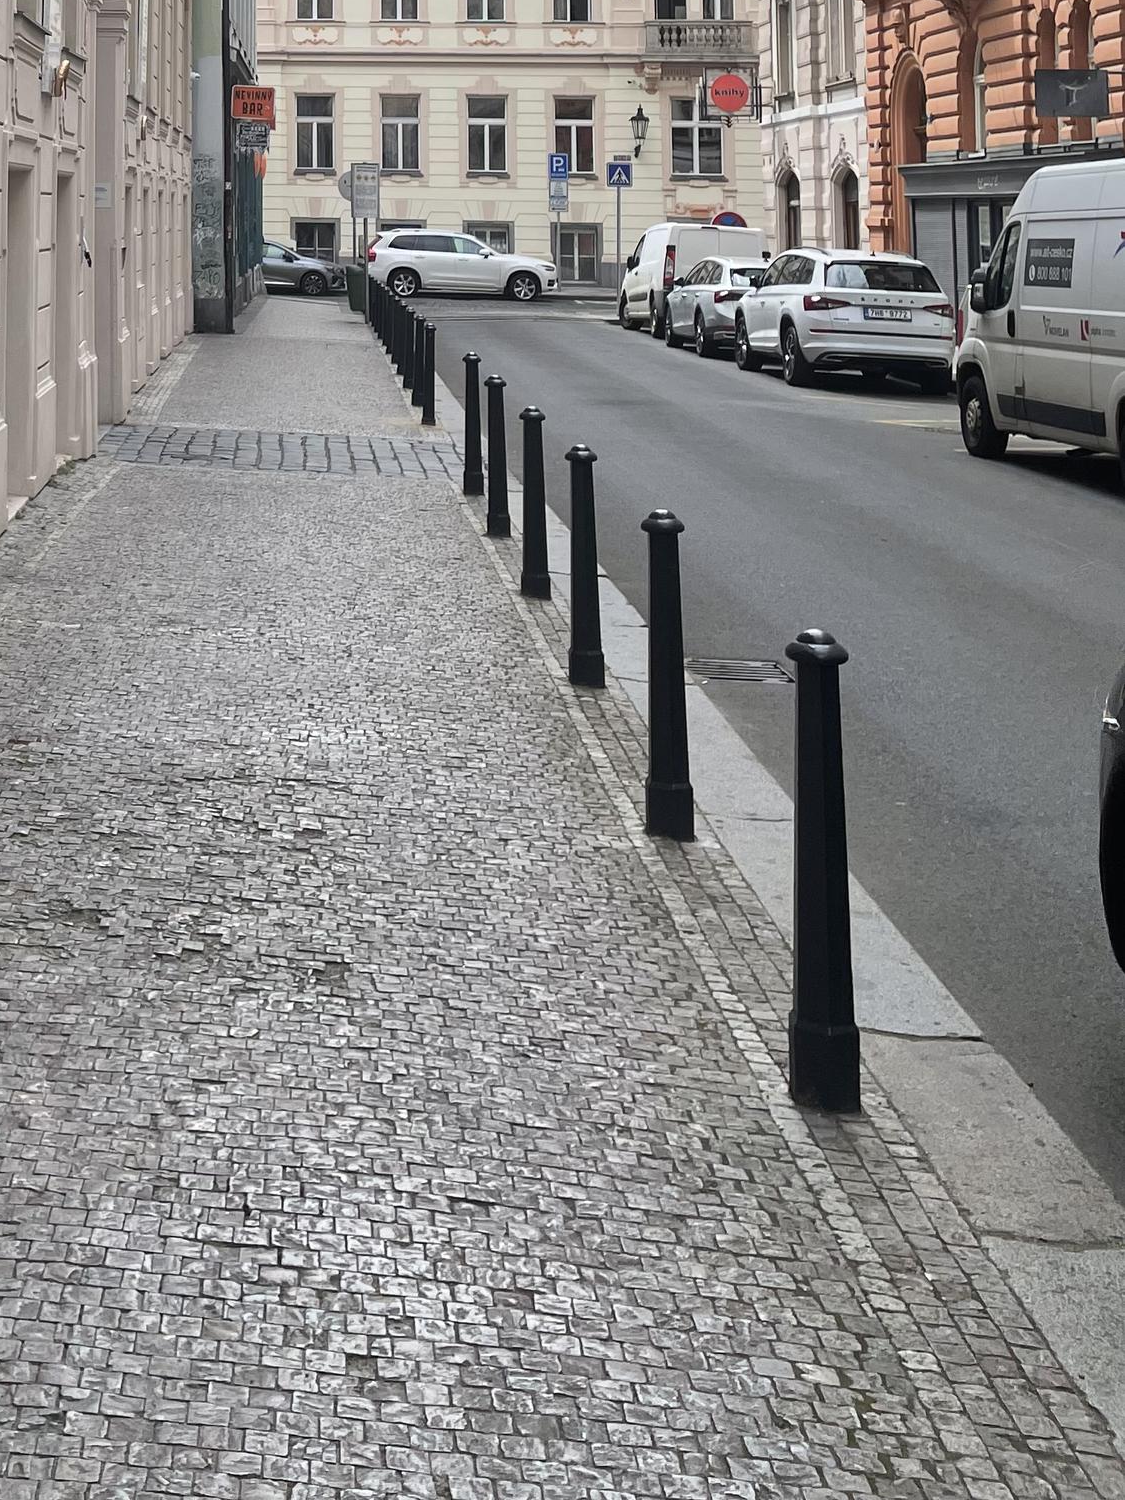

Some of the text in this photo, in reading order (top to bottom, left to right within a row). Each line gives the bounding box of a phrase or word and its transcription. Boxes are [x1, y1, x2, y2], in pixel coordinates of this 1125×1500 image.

[714, 88, 745, 99] knihy
[242, 102, 264, 116] BAR
[552, 157, 565, 172] P
